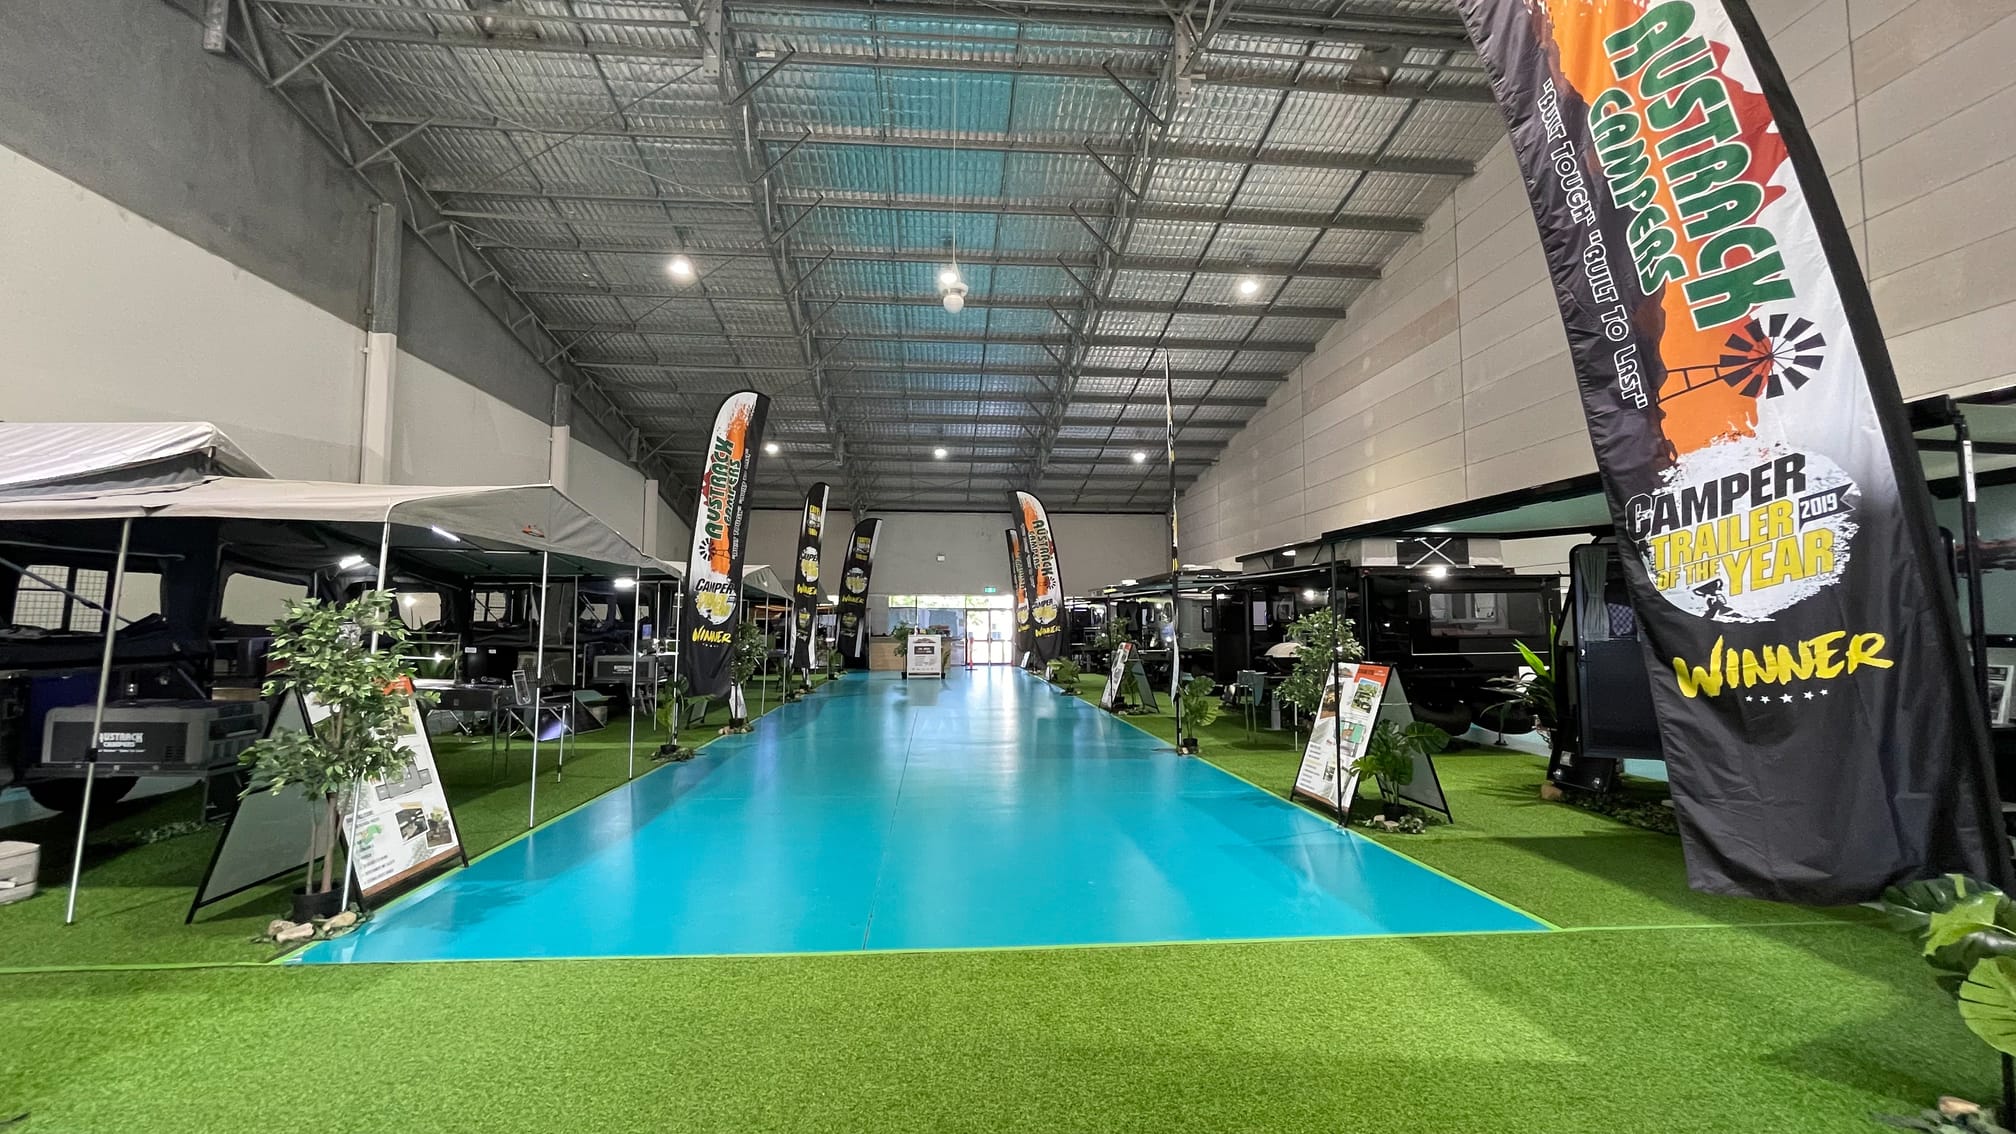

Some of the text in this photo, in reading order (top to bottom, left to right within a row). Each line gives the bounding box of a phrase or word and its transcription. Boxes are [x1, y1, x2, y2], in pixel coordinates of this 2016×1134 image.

[1587, 87, 1690, 297] CAMPERS
[1603, 0, 1796, 331] AUSTRACK
[1551, 140, 1596, 227] TOUGH"
[1601, 304, 1629, 342] TO
[704, 436, 735, 540] AUSTRACK
[1625, 452, 1806, 542] CAMPER
[1801, 492, 1838, 519] 2019
[1650, 499, 1793, 571] TRAILER
[1720, 527, 1835, 597] YEAR
[1656, 558, 1721, 592] OF THE
[691, 624, 733, 644] WINNER
[1673, 630, 1894, 699] WINNER
